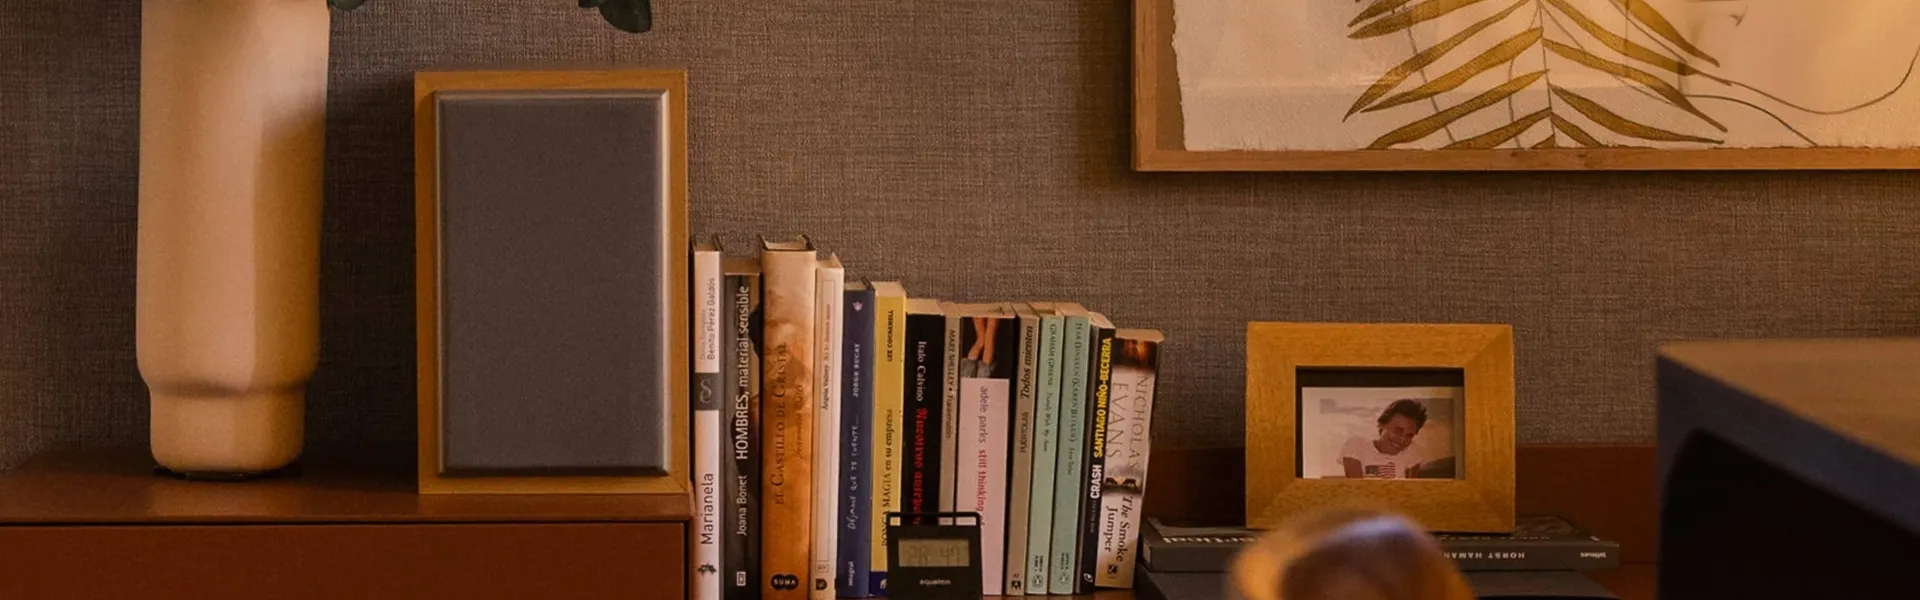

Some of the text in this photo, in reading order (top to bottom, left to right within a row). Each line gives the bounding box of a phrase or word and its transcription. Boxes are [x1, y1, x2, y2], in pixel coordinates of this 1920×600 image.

[706, 308, 716, 332] Pérez
[706, 333, 716, 360] Benito
[917, 341, 927, 362] Italo
[948, 329, 956, 352] MARY
[852, 343, 861, 398] JORGE BUCAY
[947, 354, 955, 386] SHELLEY
[1020, 325, 1033, 399] Todos mienten
[916, 365, 927, 402] Calvino
[980, 386, 988, 413] adele
[1094, 337, 1111, 458] SANTIAGO NIÑO-BECERRA
[735, 286, 750, 536] Joana Bonet HOMBRES, material sensible
[776, 402, 785, 418] DE
[1106, 382, 1130, 459] EVANS
[1127, 375, 1149, 470] NICHOLAS
[885, 408, 894, 446] empresa
[977, 415, 988, 444] parks
[850, 460, 858, 471] TE
[885, 447, 892, 458] su
[885, 460, 892, 471] en
[978, 449, 987, 468] still
[849, 475, 858, 491] QUE
[882, 473, 892, 509] MAGIA
[975, 471, 987, 512] thinking
[1090, 464, 1102, 499] CRASH
[700, 473, 714, 545] Marianela
[1104, 504, 1119, 553] Jumper
[1116, 495, 1133, 563] The Smoke
[1487, 551, 1526, 560] HORST
[773, 579, 796, 587] SUMA
